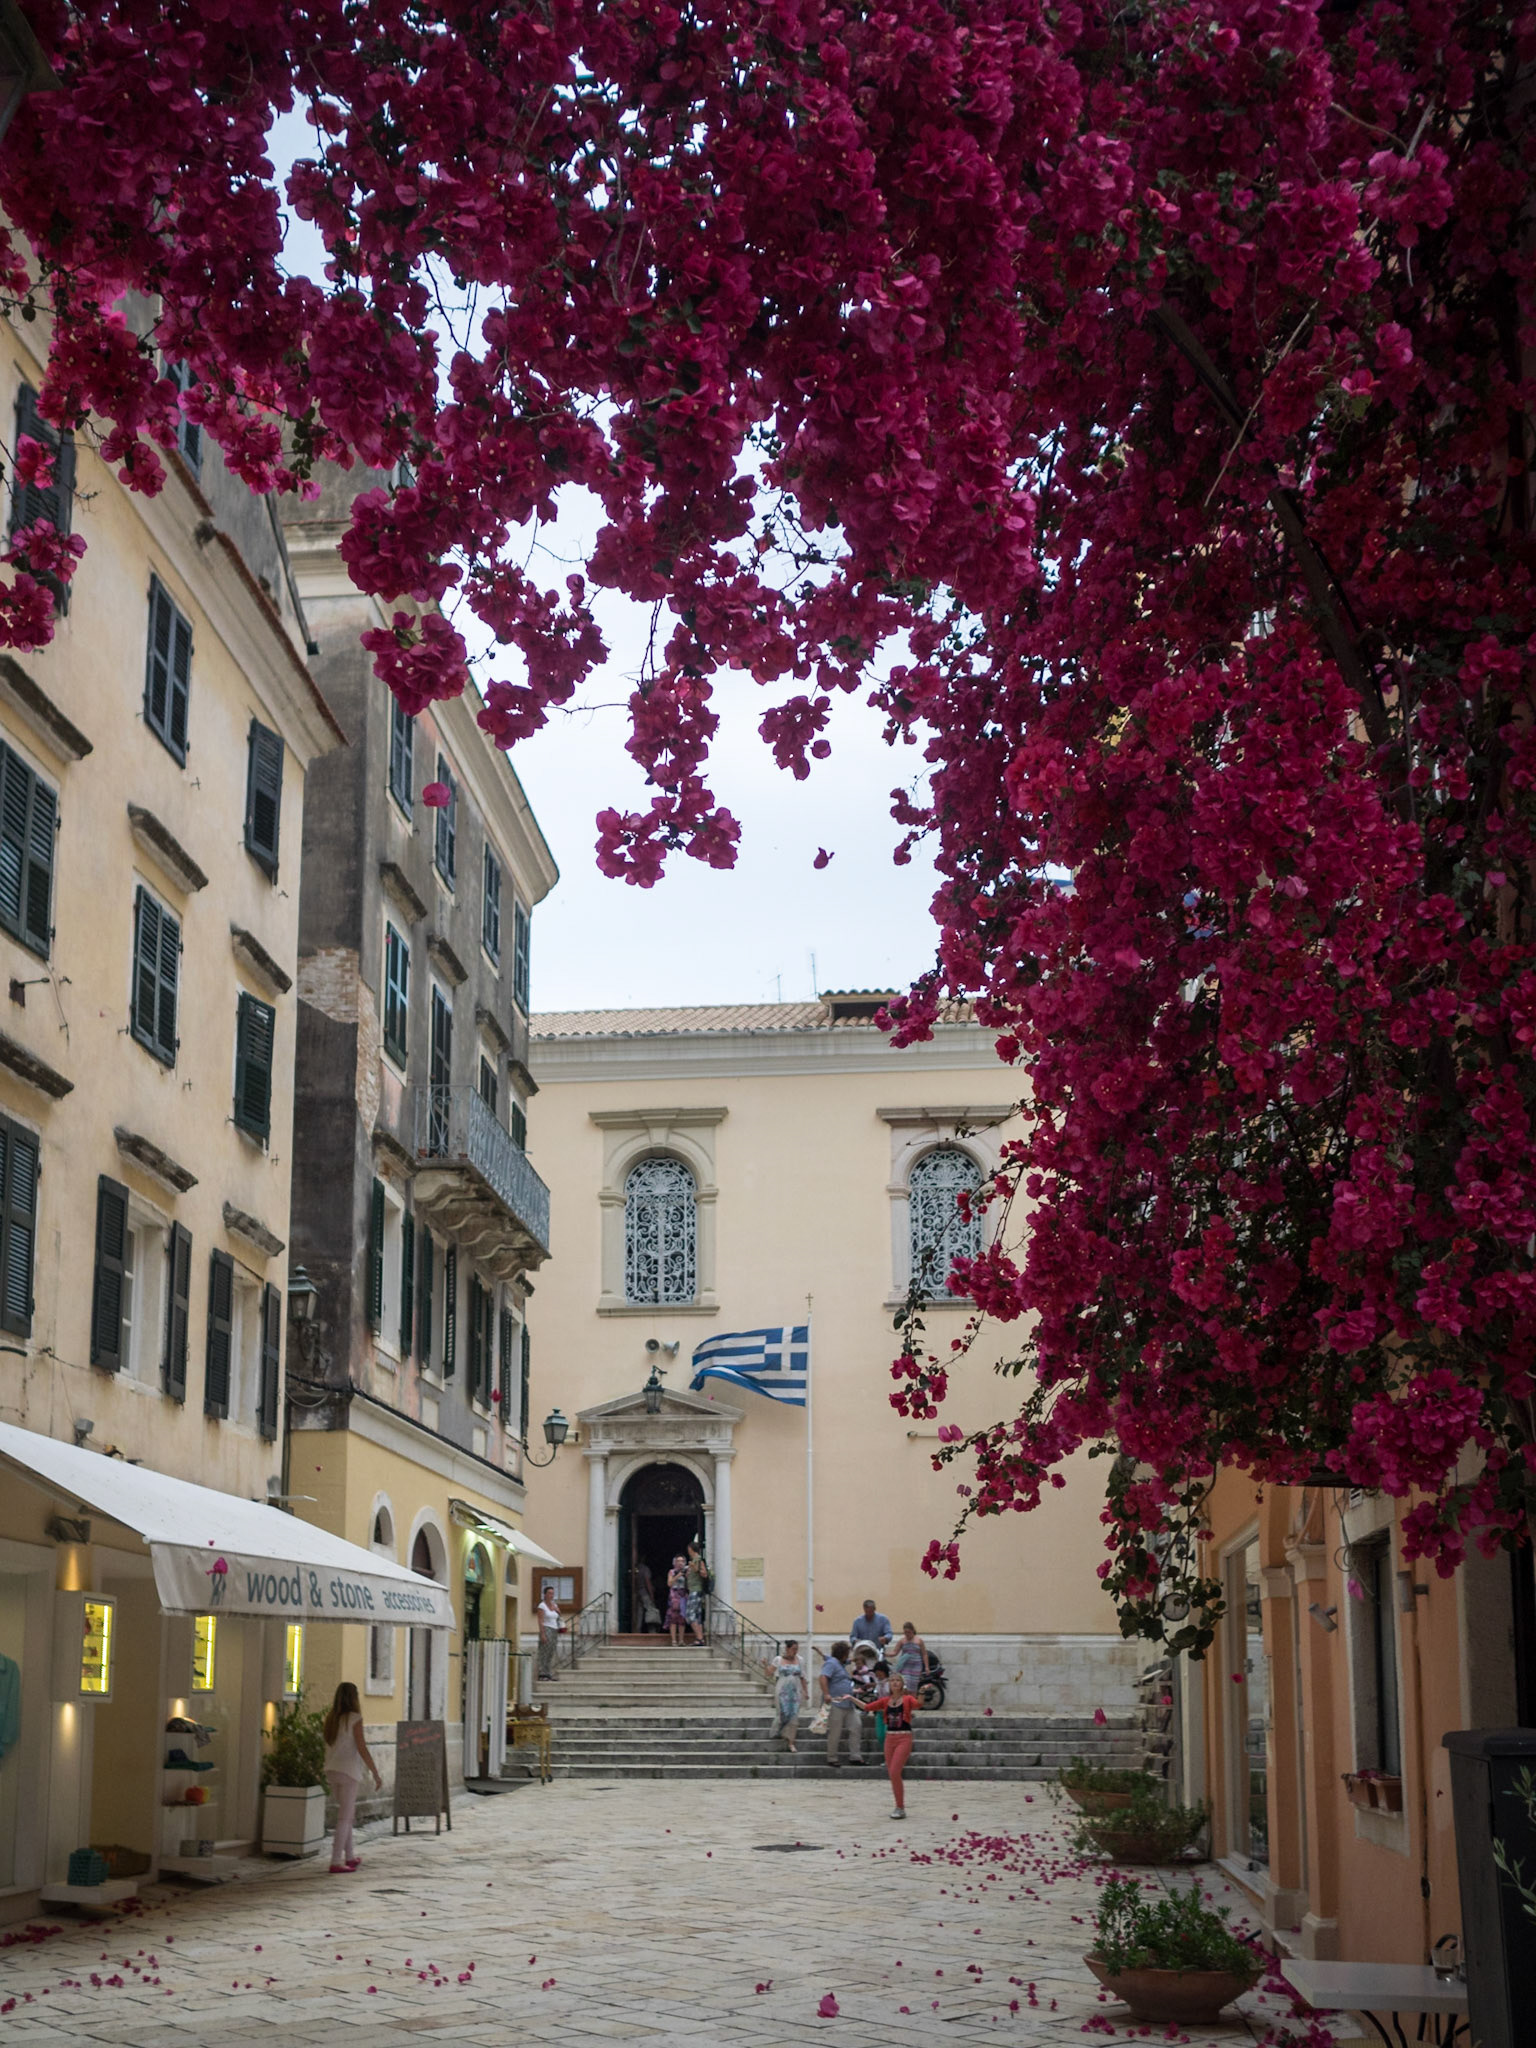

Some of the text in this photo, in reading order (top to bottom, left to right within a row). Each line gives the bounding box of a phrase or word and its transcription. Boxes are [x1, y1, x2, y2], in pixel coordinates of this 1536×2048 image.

[247, 1566, 436, 1614] wood & stone accessories
